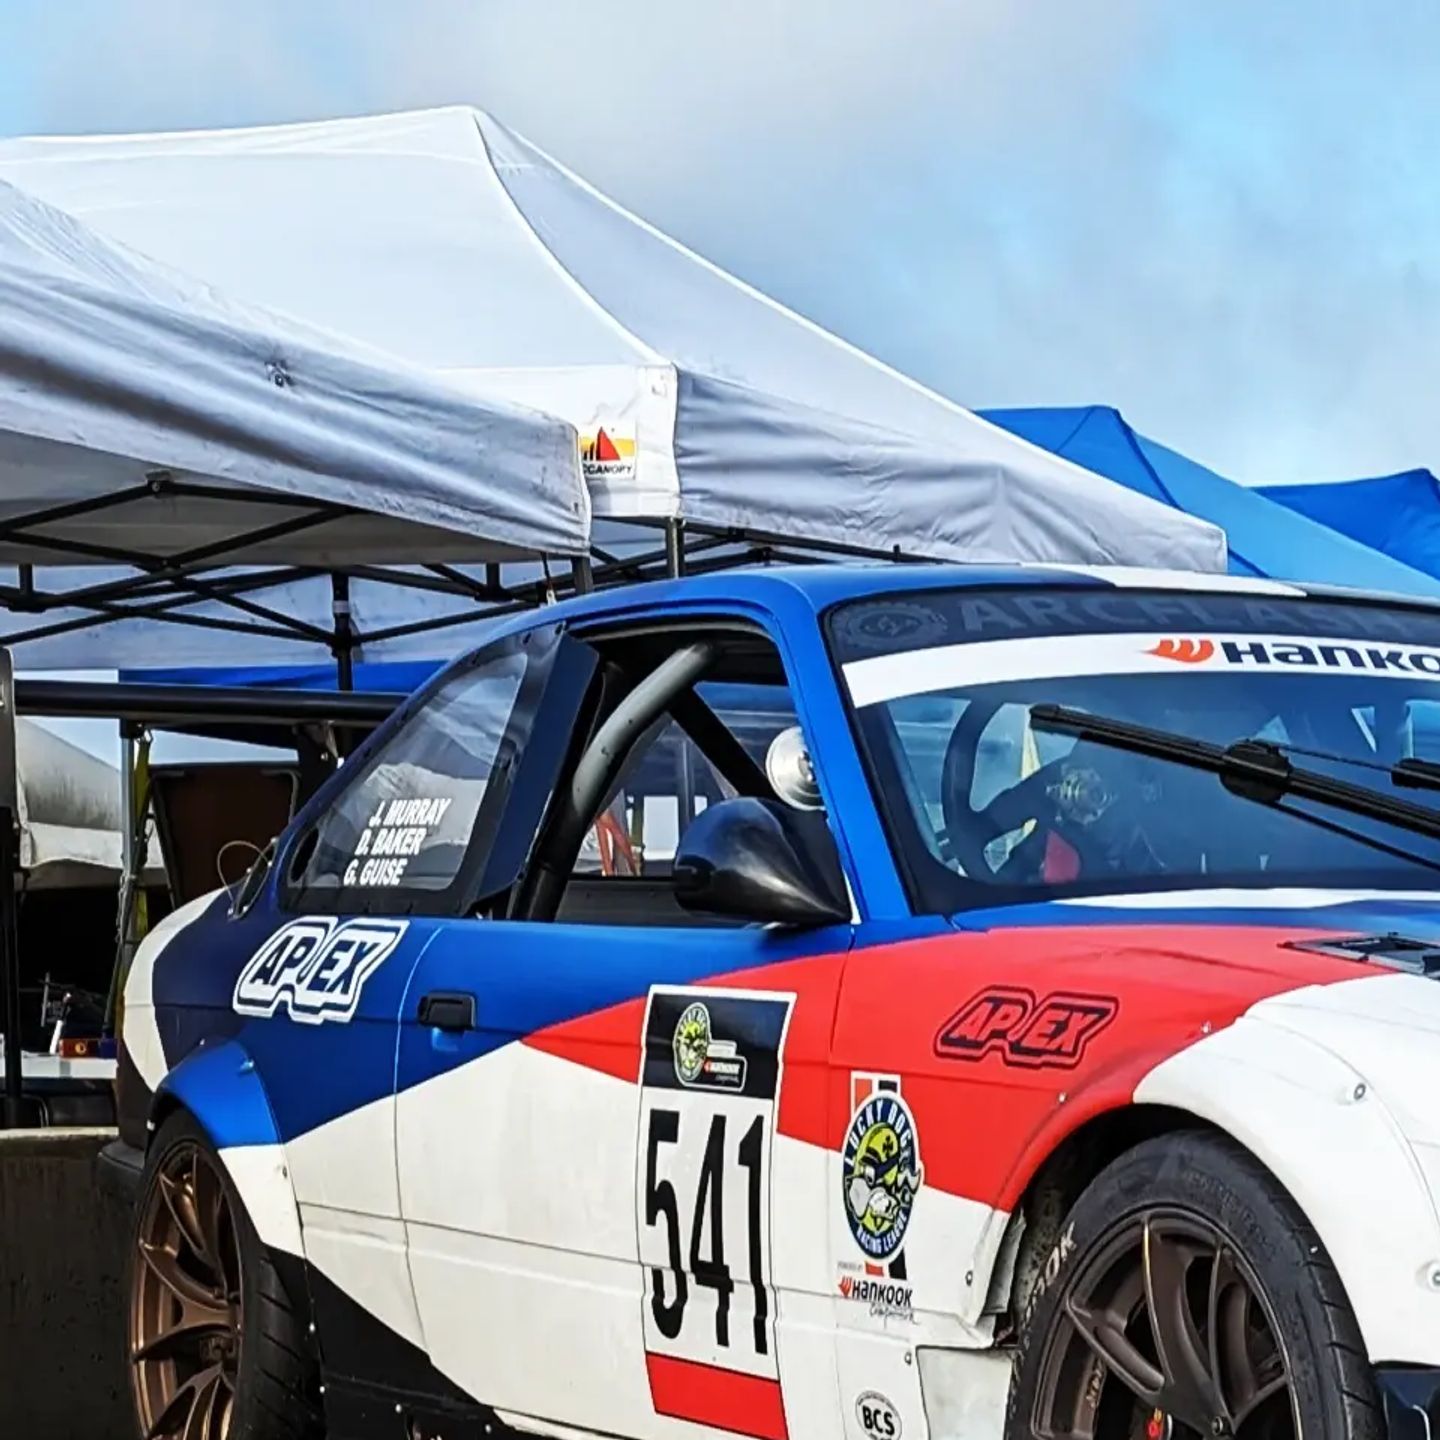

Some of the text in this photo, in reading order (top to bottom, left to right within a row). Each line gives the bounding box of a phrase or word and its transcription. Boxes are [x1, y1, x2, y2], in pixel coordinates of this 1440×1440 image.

[368, 798, 452, 829] J. MURRAY
[354, 827, 428, 856] D. BAKER
[359, 858, 409, 887] GUISE
[240, 926, 397, 1004] APEX
[941, 994, 1111, 1058] APEX
[844, 1099, 912, 1166] LUCKY DOG
[644, 1108, 769, 1355] 541
[862, 1405, 895, 1436] BCS
